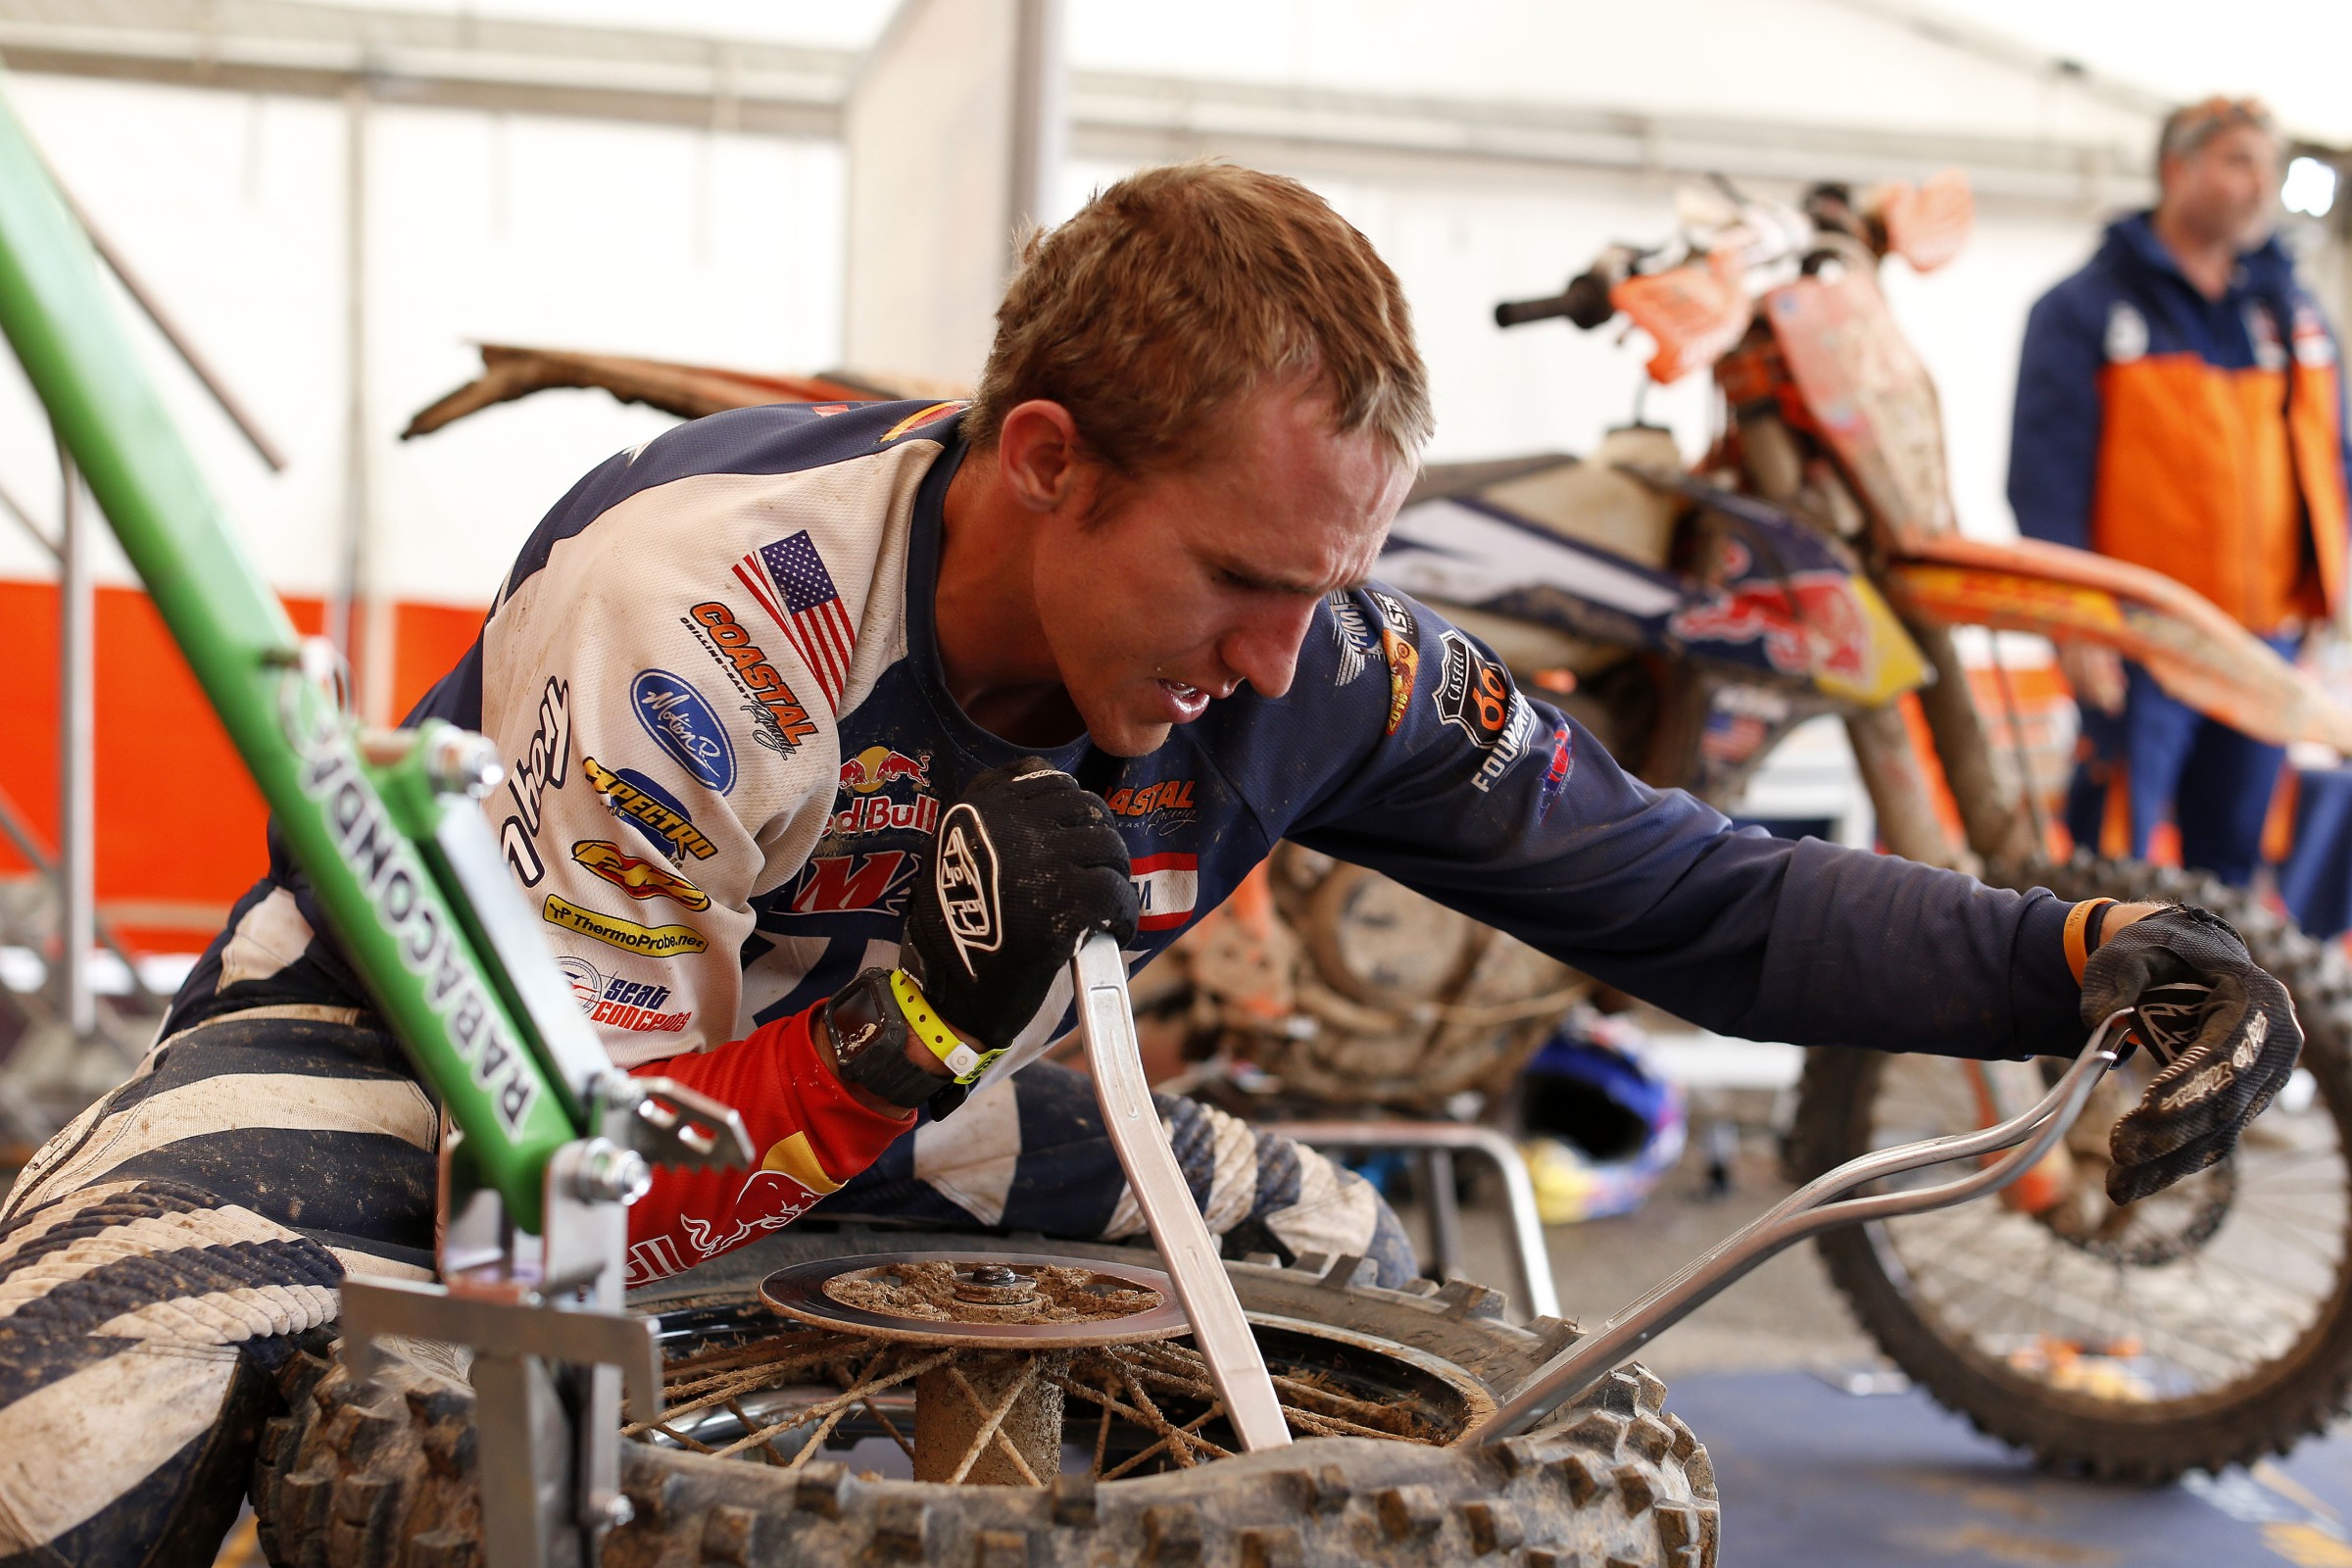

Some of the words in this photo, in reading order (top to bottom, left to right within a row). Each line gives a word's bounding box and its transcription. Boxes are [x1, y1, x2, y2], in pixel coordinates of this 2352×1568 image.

[679, 616, 724, 665] DRILLING
[726, 672, 752, 700] EAST
[690, 602, 819, 746] COASTAL
[1446, 647, 1465, 702] CASELLI
[642, 691, 696, 752] Motion
[863, 794, 940, 835] Bull
[1104, 781, 1196, 816] ASTAL
[571, 914, 704, 951] ThermoProbe.net
[604, 979, 671, 1010] seat
